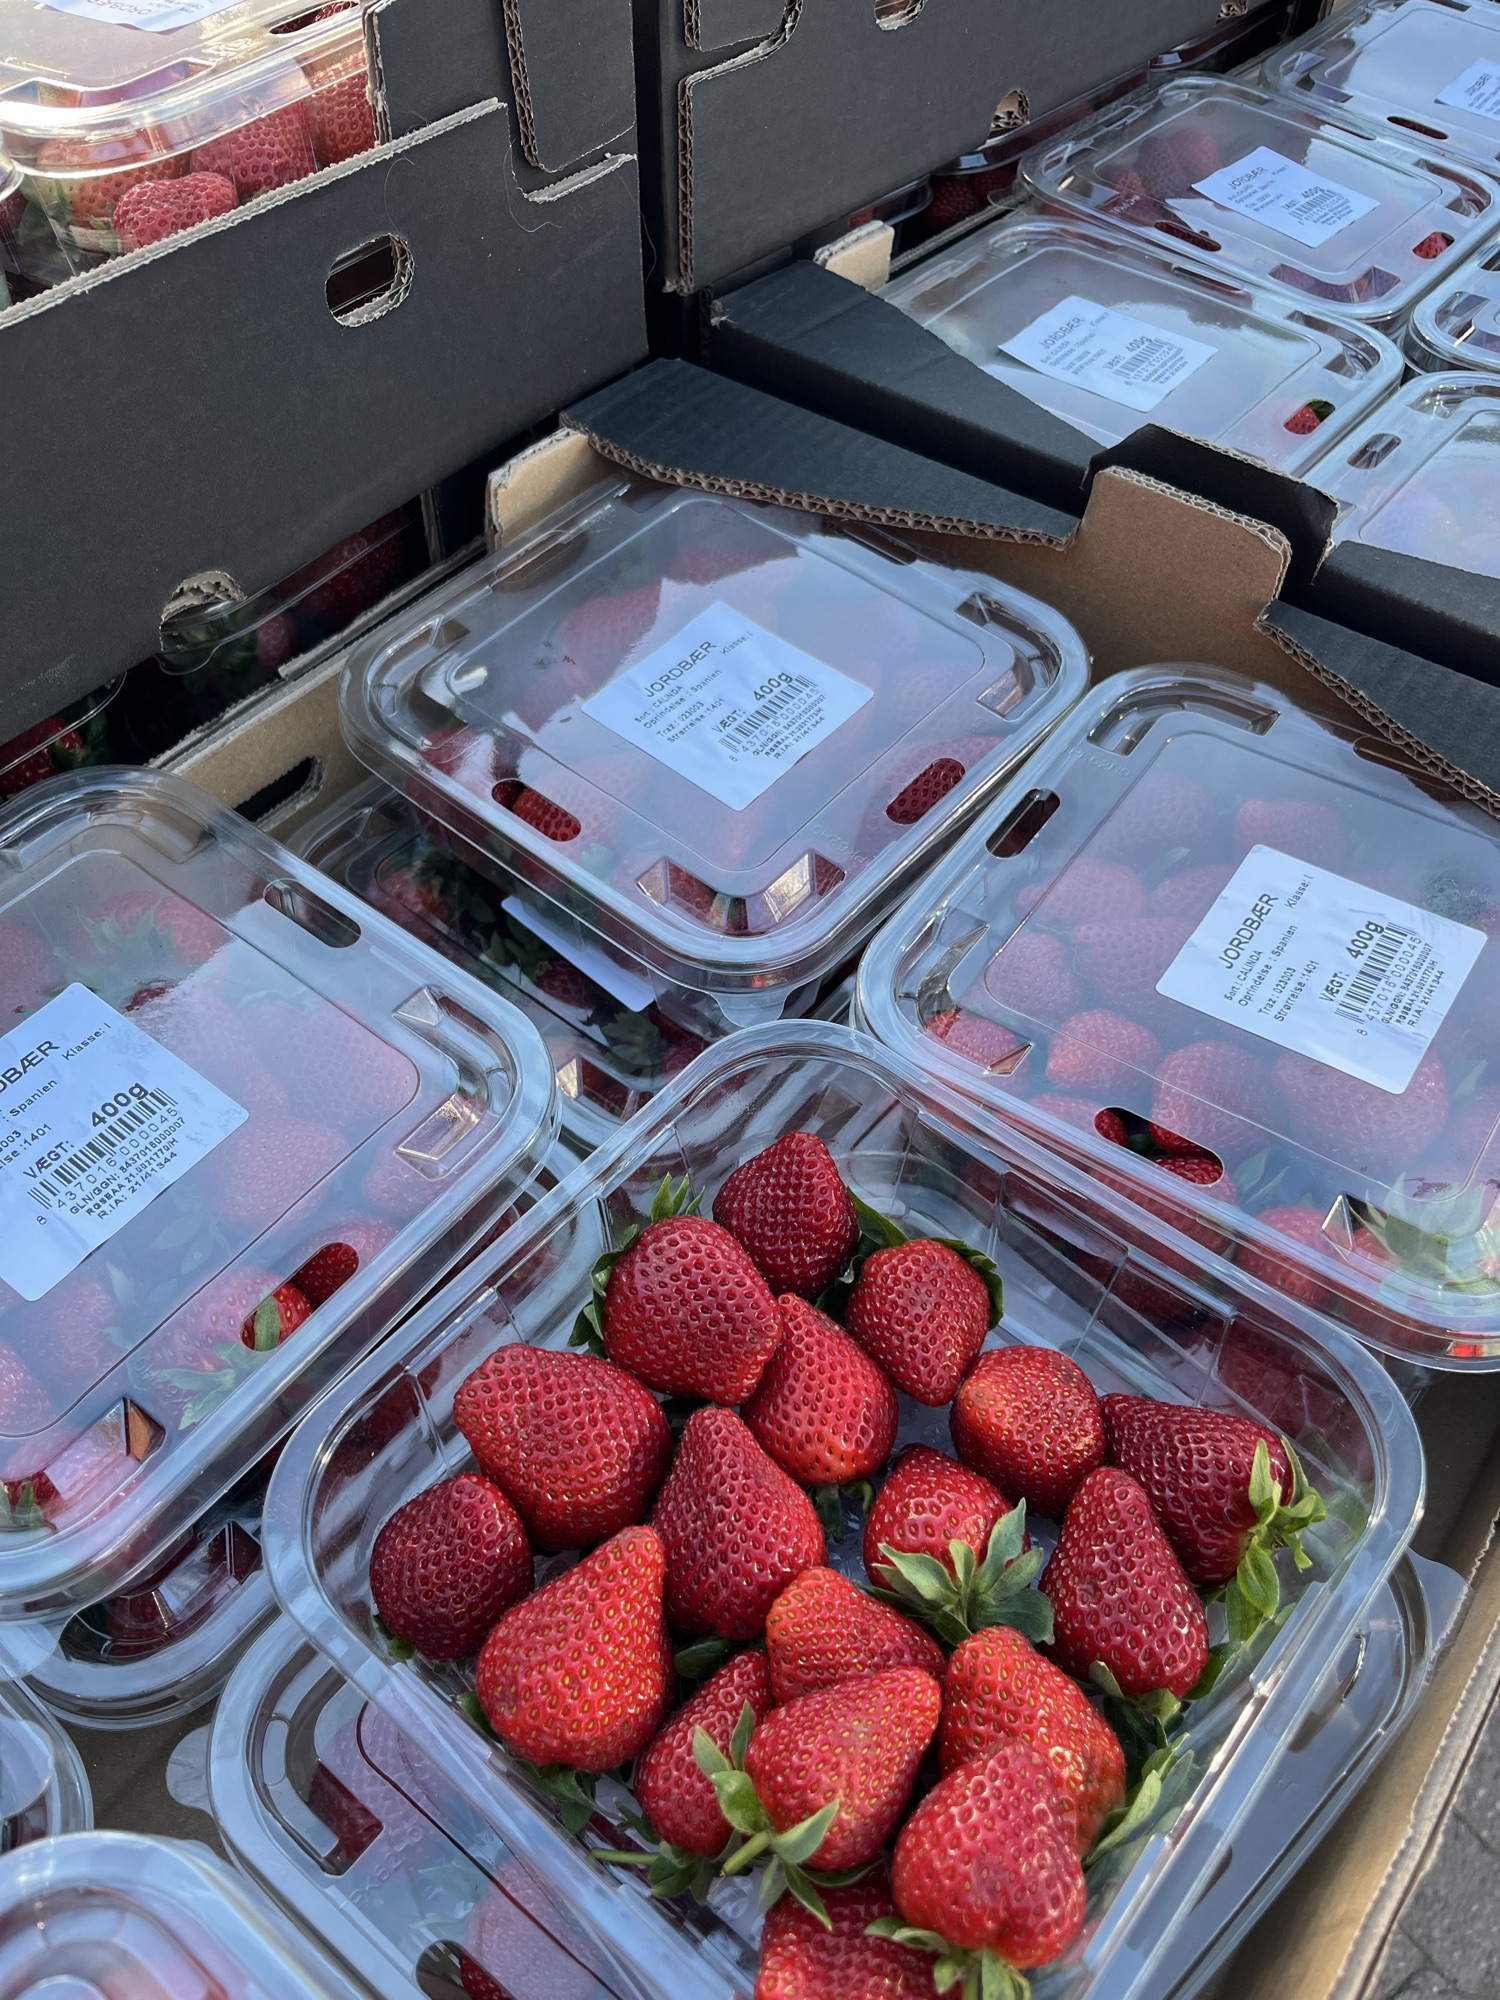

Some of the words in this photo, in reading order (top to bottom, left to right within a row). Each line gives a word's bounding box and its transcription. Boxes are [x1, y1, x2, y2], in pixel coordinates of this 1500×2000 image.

[644, 642, 716, 697] JORDBÆR
[754, 672, 793, 702] 400g
[1219, 894, 1278, 969] JORDBÆR
[1271, 926, 1297, 956] Spanien
[1237, 951, 1263, 981] CALINDA
[1319, 972, 1349, 1002] VÆGT:
[1346, 921, 1386, 959] 400g
[1273, 968, 1296, 993] 023003
[1420, 970, 1445, 1005] 21/41344
[62, 1028, 105, 1060] Klasse:
[10, 1080, 57, 1116] Spanien
[23, 1141, 74, 1178] VÆGT:
[92, 1083, 150, 1127] 400g
[128, 1152, 177, 1194] 21/41344
[70, 1173, 120, 1214] GLN/GGN:
